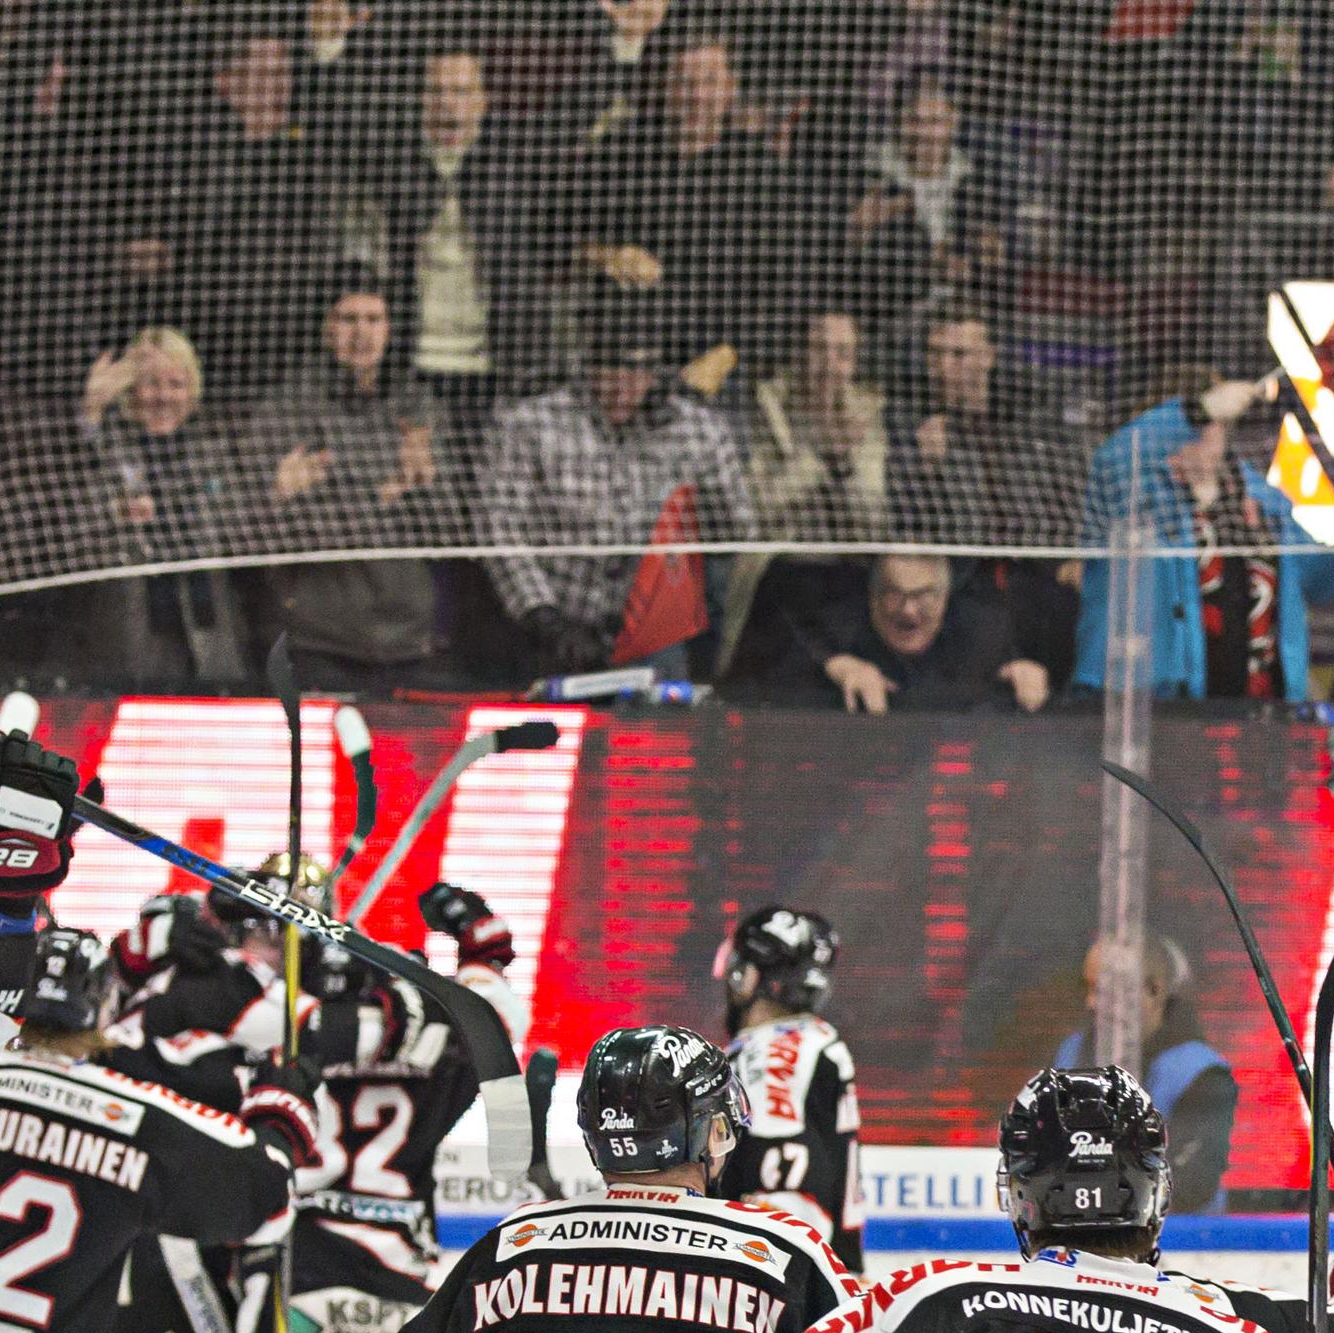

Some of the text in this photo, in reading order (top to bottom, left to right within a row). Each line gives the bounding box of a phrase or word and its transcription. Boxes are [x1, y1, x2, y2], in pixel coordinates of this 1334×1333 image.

[657, 1034, 707, 1077] Panda
[600, 1107, 635, 1131] Panda
[610, 1136, 638, 1157] 55
[1070, 1129, 1114, 1158] Panda
[1075, 1186, 1103, 1209] 81
[548, 1220, 728, 1253] ADMINISTER
